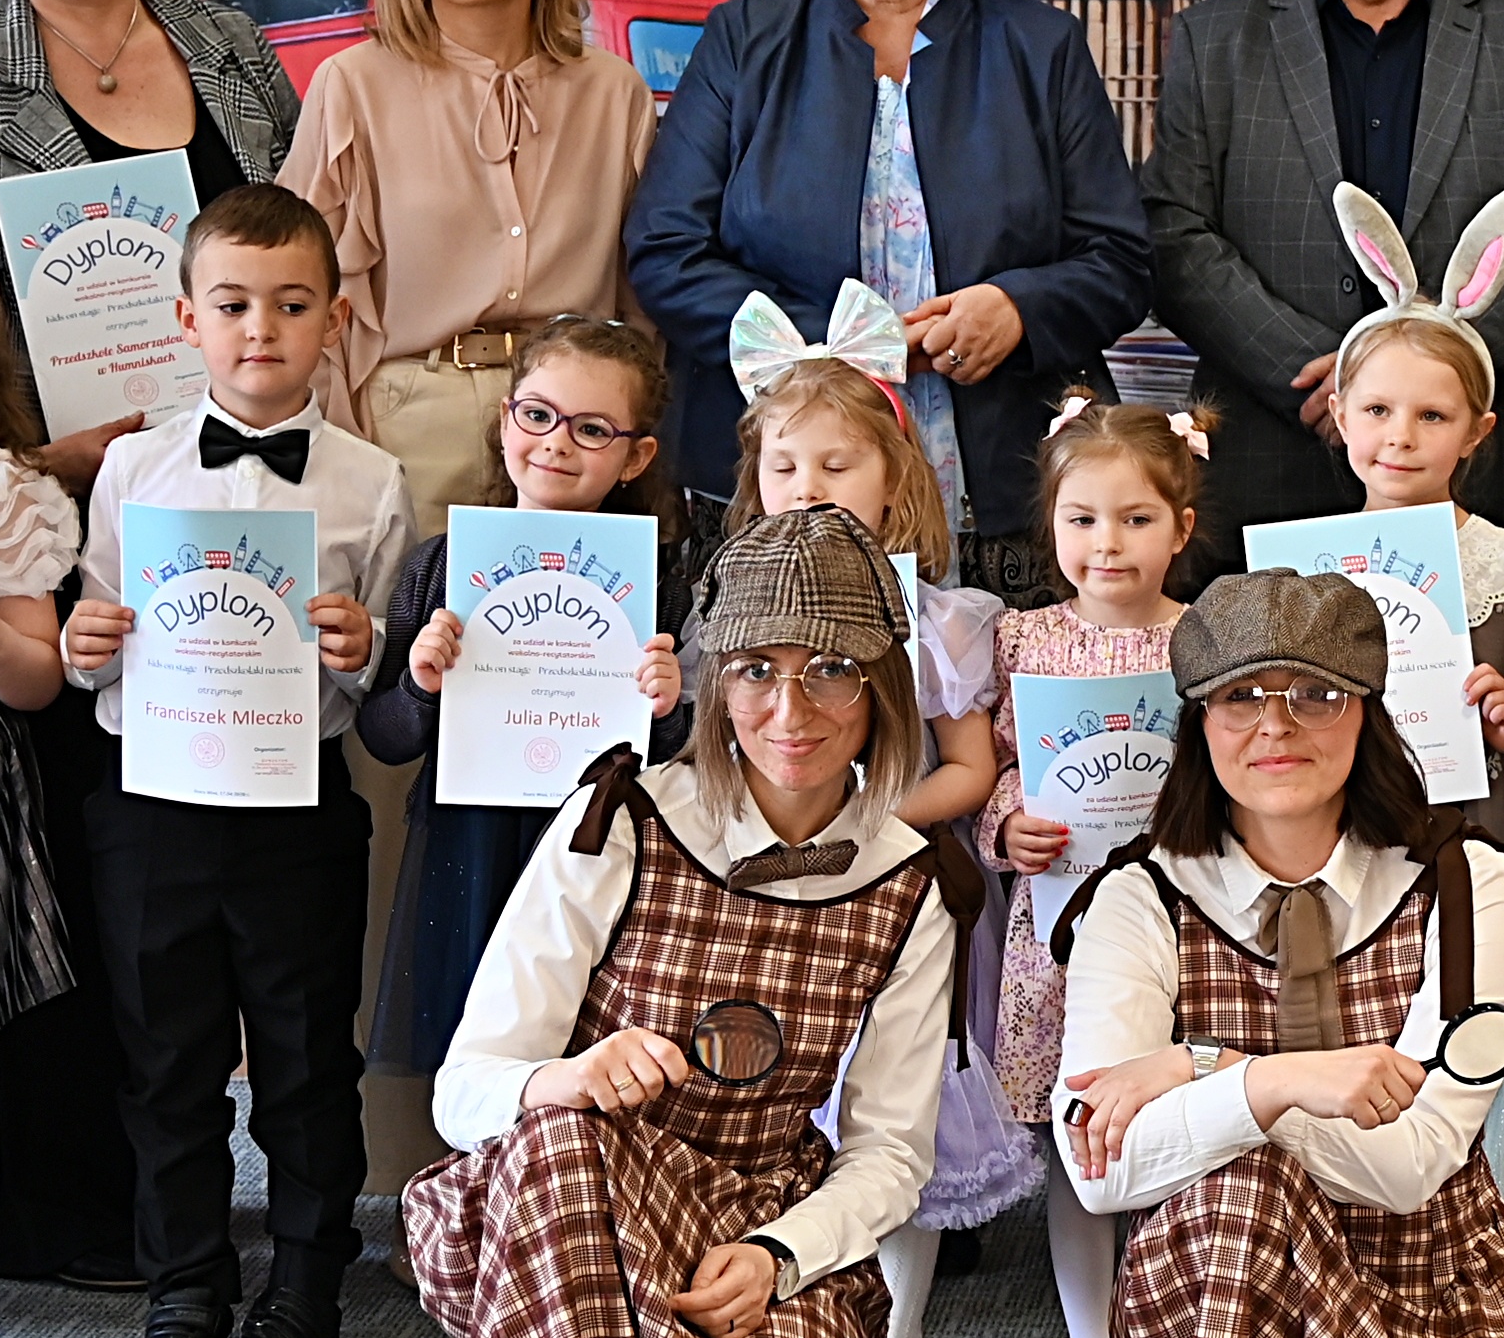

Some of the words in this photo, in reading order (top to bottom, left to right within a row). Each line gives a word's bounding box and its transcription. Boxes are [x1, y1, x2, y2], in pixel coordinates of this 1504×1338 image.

[44, 229, 165, 286] Dyplom
[116, 272, 151, 284] konkursie
[50, 347, 113, 366] Przedszkole
[117, 335, 184, 354] Samorządow
[98, 367, 106, 375] w
[109, 352, 176, 373] Humniskach
[154, 583, 274, 636] Dyplom
[484, 585, 610, 640] Dyplom
[198, 687, 242, 697] otrzymuje
[531, 689, 575, 698] otrzymuje
[145, 701, 226, 725] Franciszek
[233, 709, 303, 725] Mleczko
[504, 709, 542, 726] Julia
[549, 711, 600, 730] Pytlak
[1395, 710, 1428, 725] cios
[1063, 860, 1101, 874] Zuza
